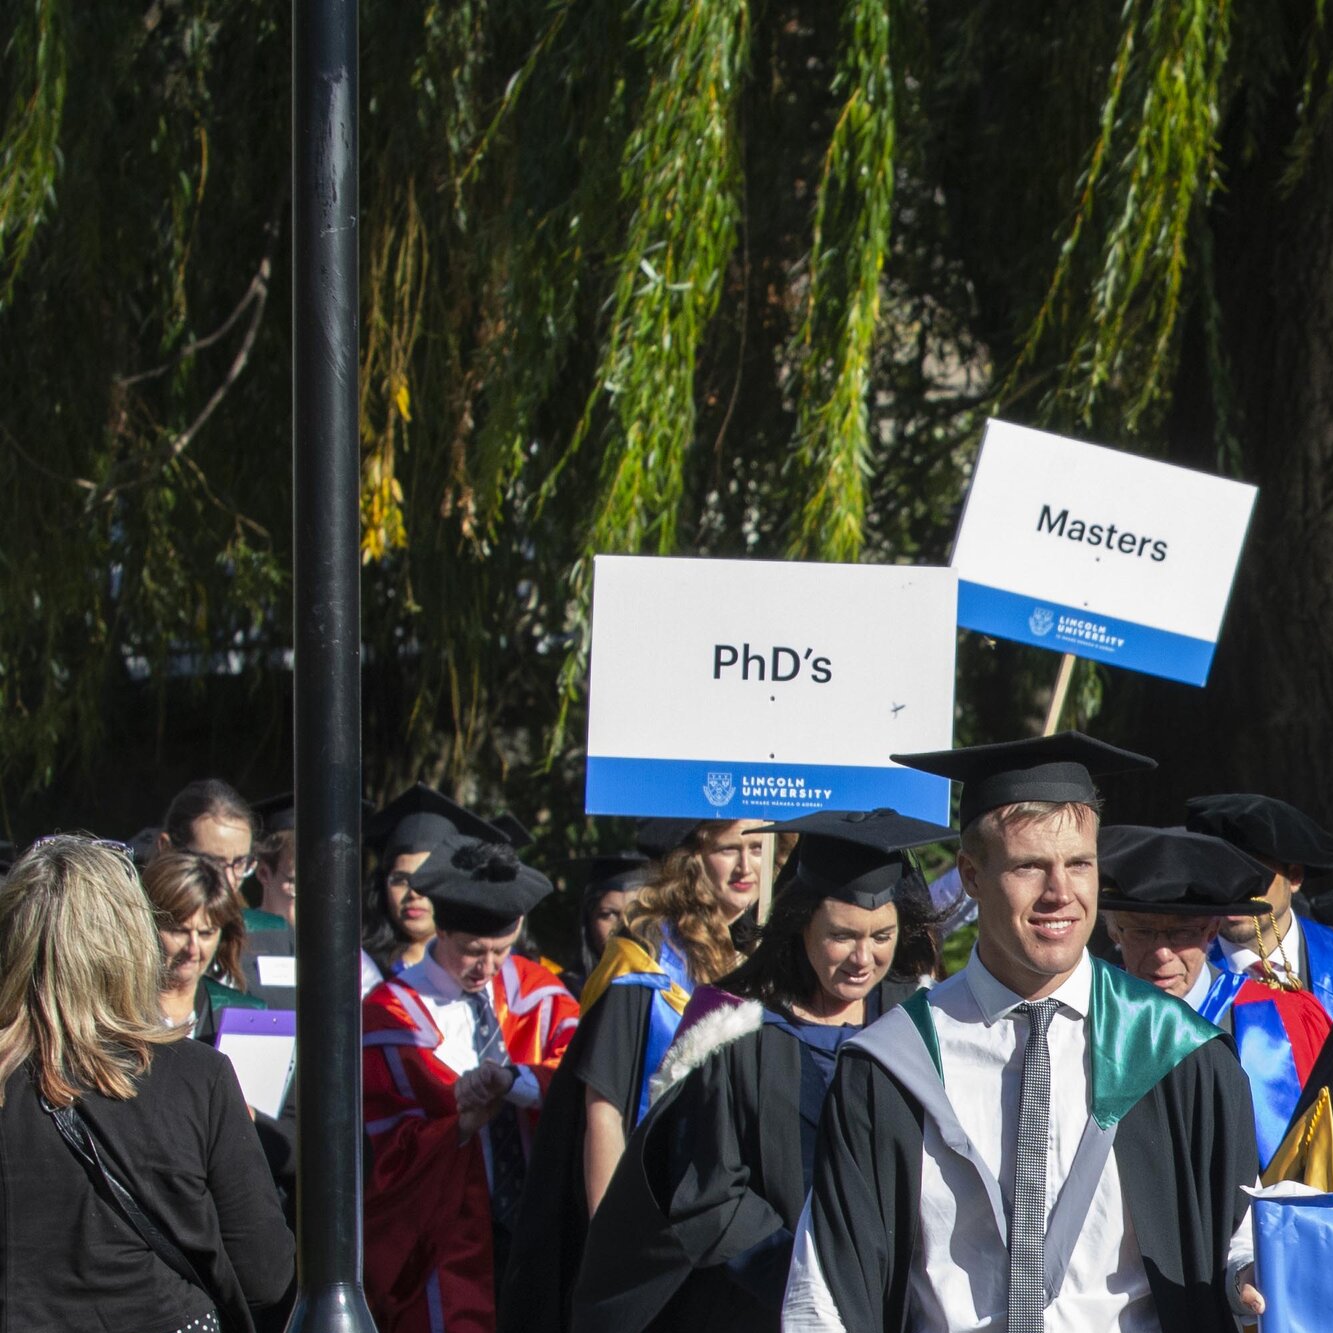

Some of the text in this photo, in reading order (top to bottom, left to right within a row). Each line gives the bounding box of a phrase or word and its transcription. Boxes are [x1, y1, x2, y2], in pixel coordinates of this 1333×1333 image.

[1036, 503, 1168, 562] Masters
[1059, 615, 1107, 634] LINCOLN
[1057, 624, 1125, 648] UNIVERSITY
[713, 643, 832, 684] PhD's
[742, 776, 805, 788] LINCOLN
[742, 787, 832, 800] UNIVERSITY
